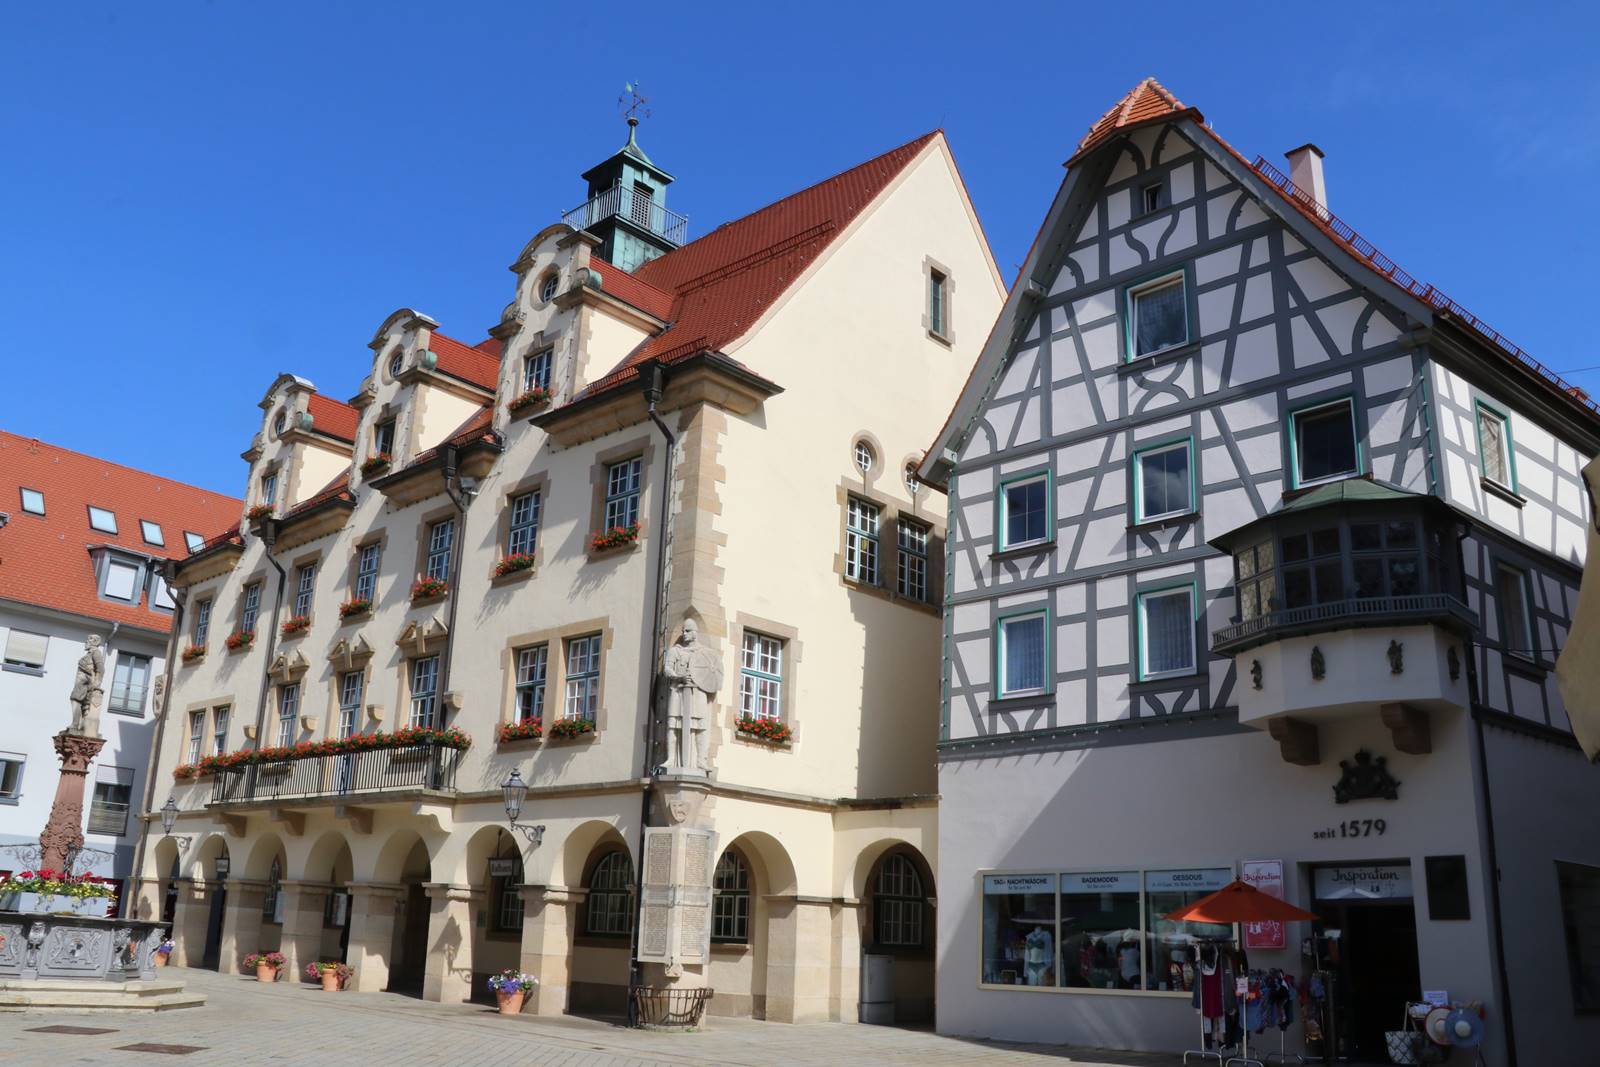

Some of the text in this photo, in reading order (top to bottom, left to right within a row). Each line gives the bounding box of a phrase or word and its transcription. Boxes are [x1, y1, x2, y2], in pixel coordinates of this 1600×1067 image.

[1313, 818, 1387, 839] seit 1579
[1332, 867, 1400, 885] Inspiration
